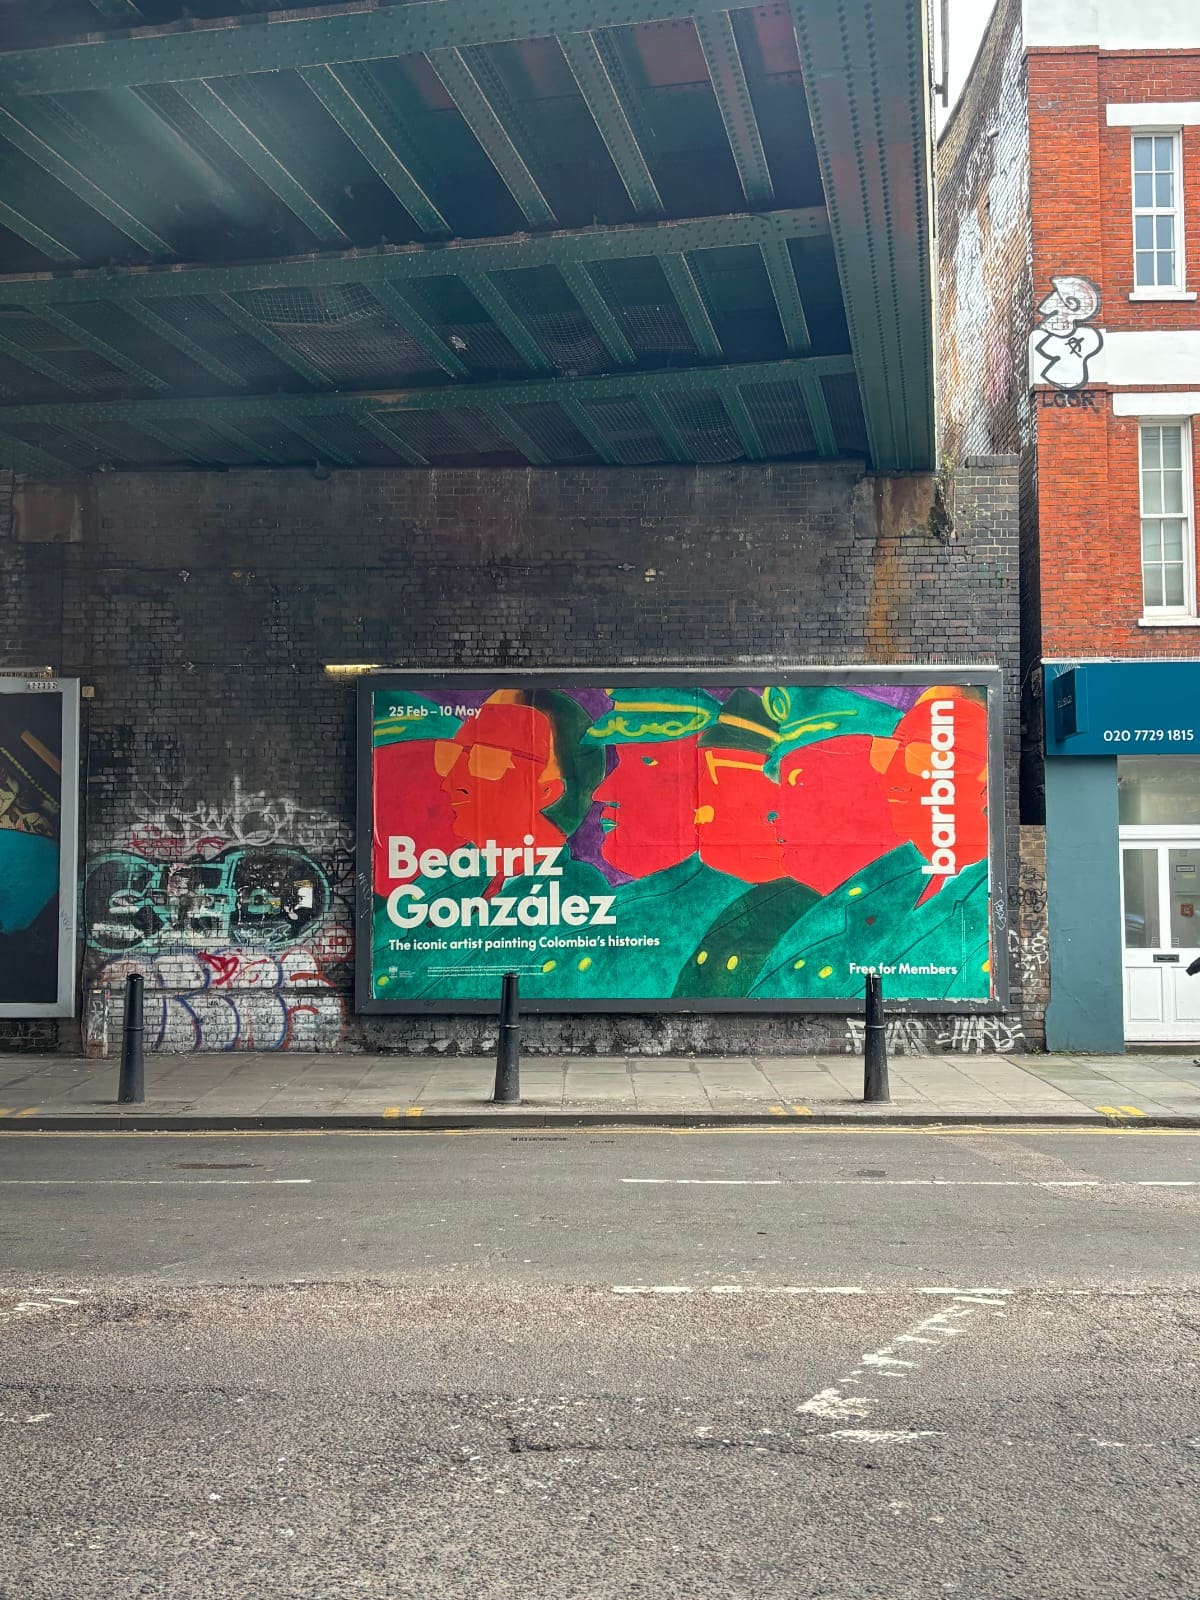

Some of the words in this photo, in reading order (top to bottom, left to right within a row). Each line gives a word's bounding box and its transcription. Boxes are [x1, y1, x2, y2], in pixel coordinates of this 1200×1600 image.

[388, 706, 404, 717] 25
[407, 705, 428, 717] Feb
[440, 706, 452, 717] 10
[455, 705, 482, 719] May
[1103, 730, 1131, 742] 020
[1134, 729, 1164, 741] 7729
[1167, 729, 1194, 741] 1815
[921, 700, 956, 875] barbican
[388, 834, 563, 878] Beatriz
[387, 881, 617, 928] González
[389, 939, 411, 950] The
[413, 939, 447, 950] iconic
[450, 938, 483, 949] artist
[485, 937, 537, 951] painting
[608, 935, 660, 947] histories
[849, 963, 876, 975] Free
[879, 962, 897, 975] for
[899, 963, 958, 975] Members
